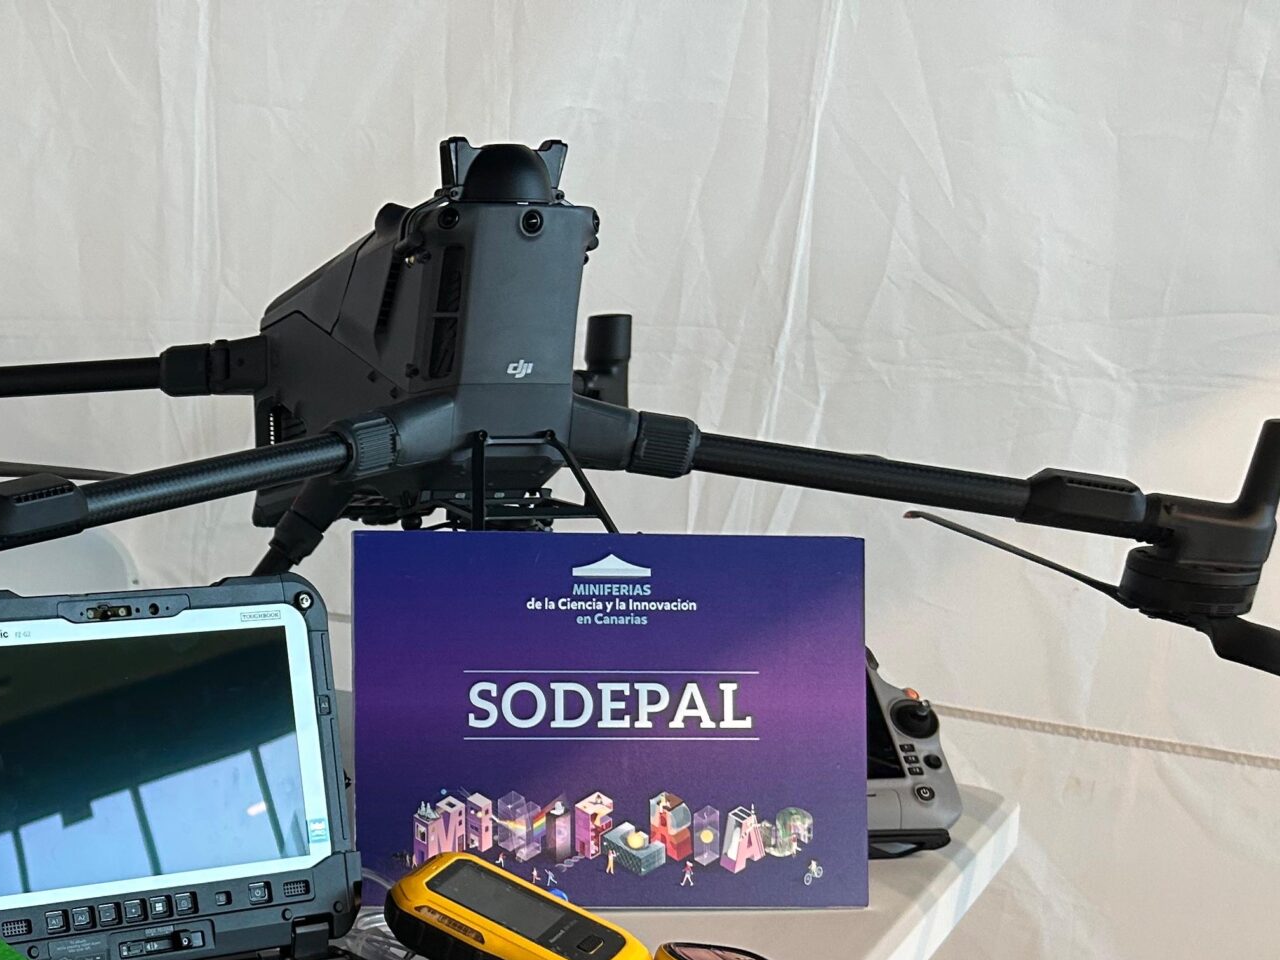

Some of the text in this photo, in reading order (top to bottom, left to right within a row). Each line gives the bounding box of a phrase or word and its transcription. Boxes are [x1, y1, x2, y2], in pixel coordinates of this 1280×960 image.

[572, 583, 652, 596] MINIFERIAS
[526, 598, 697, 613] de la Ciencia y la Innovación
[576, 612, 648, 625] en Canarias
[468, 681, 752, 729] SODEPAL
